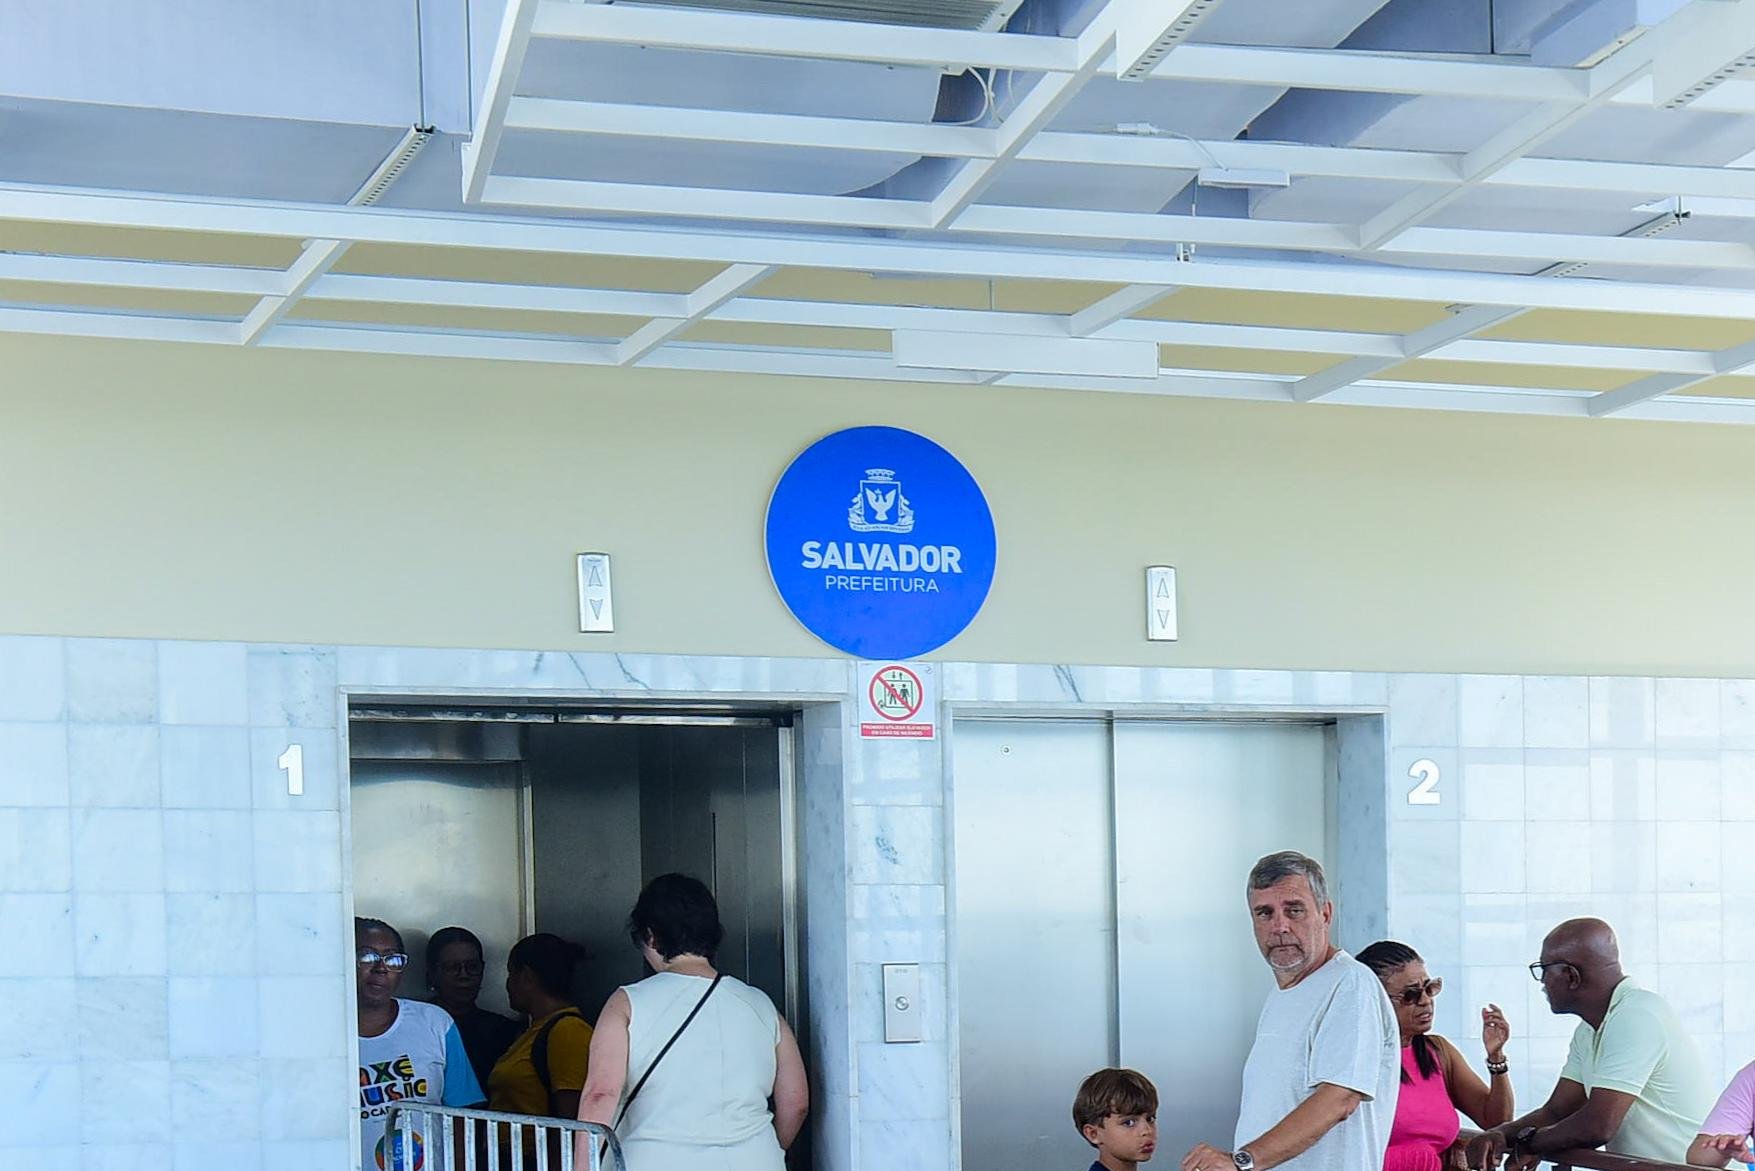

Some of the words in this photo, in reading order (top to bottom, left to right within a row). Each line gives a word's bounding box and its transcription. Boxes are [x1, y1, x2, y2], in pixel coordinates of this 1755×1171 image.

[801, 541, 963, 573] SALVADOR
[825, 575, 940, 592] PREFEITURA
[278, 744, 303, 795] 1
[1407, 758, 1440, 805] 2
[360, 1078, 427, 1107] USIC
